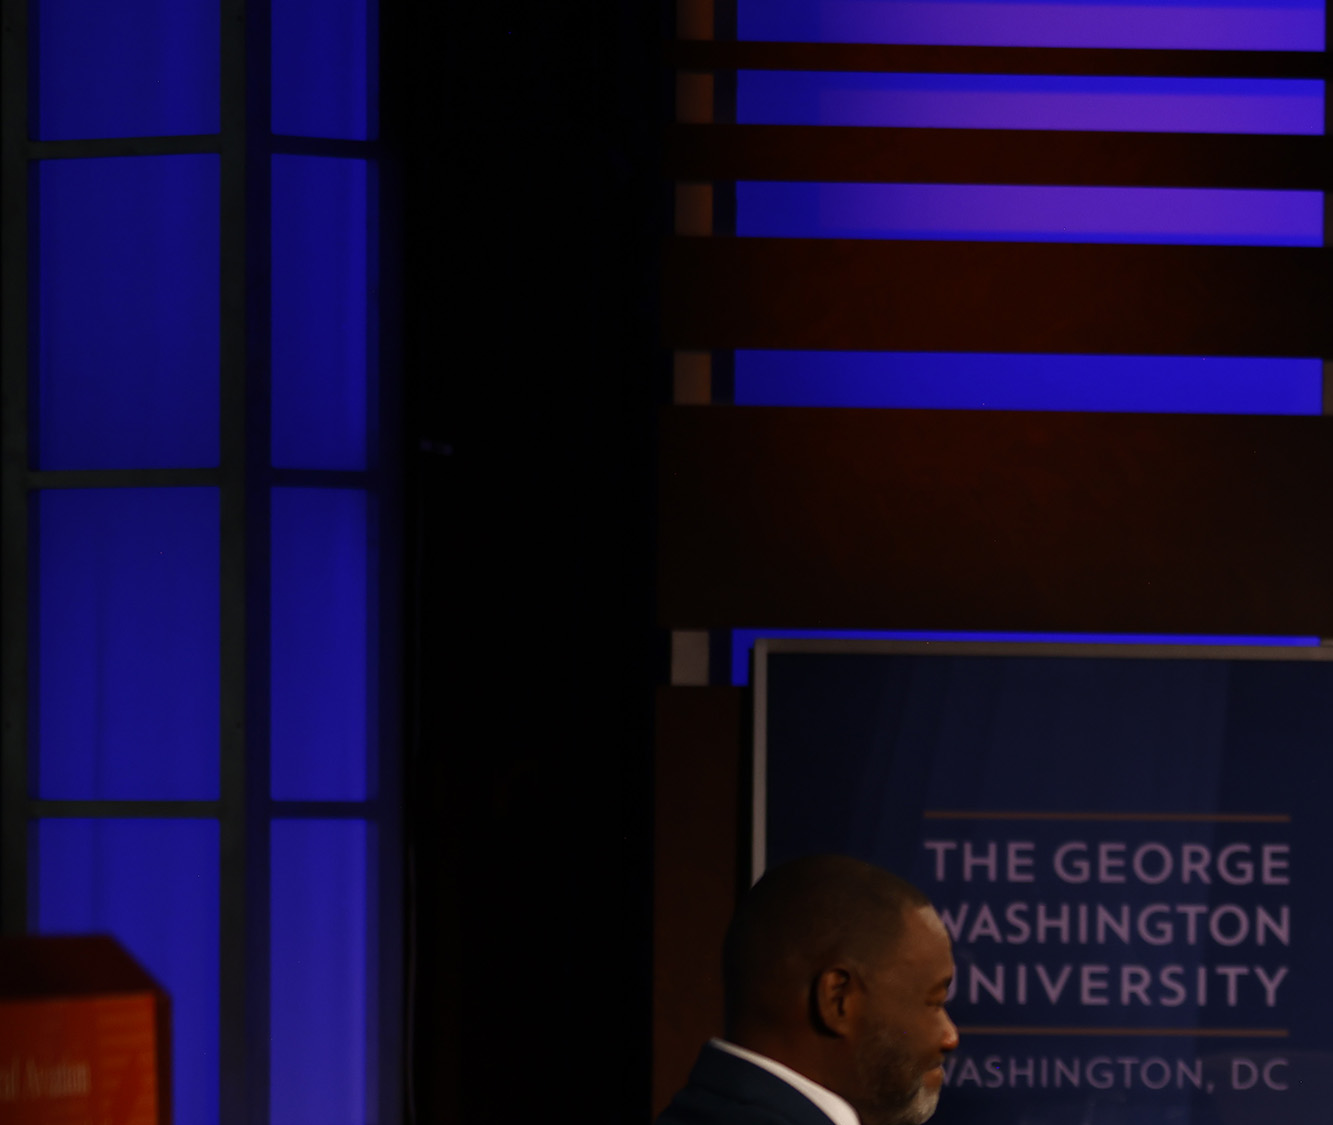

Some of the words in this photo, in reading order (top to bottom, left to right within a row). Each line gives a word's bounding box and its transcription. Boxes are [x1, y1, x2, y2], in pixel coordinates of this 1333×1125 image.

[924, 840, 1035, 883] THE
[1053, 841, 1291, 886] GEORGE
[1230, 1057, 1290, 1092] DC
